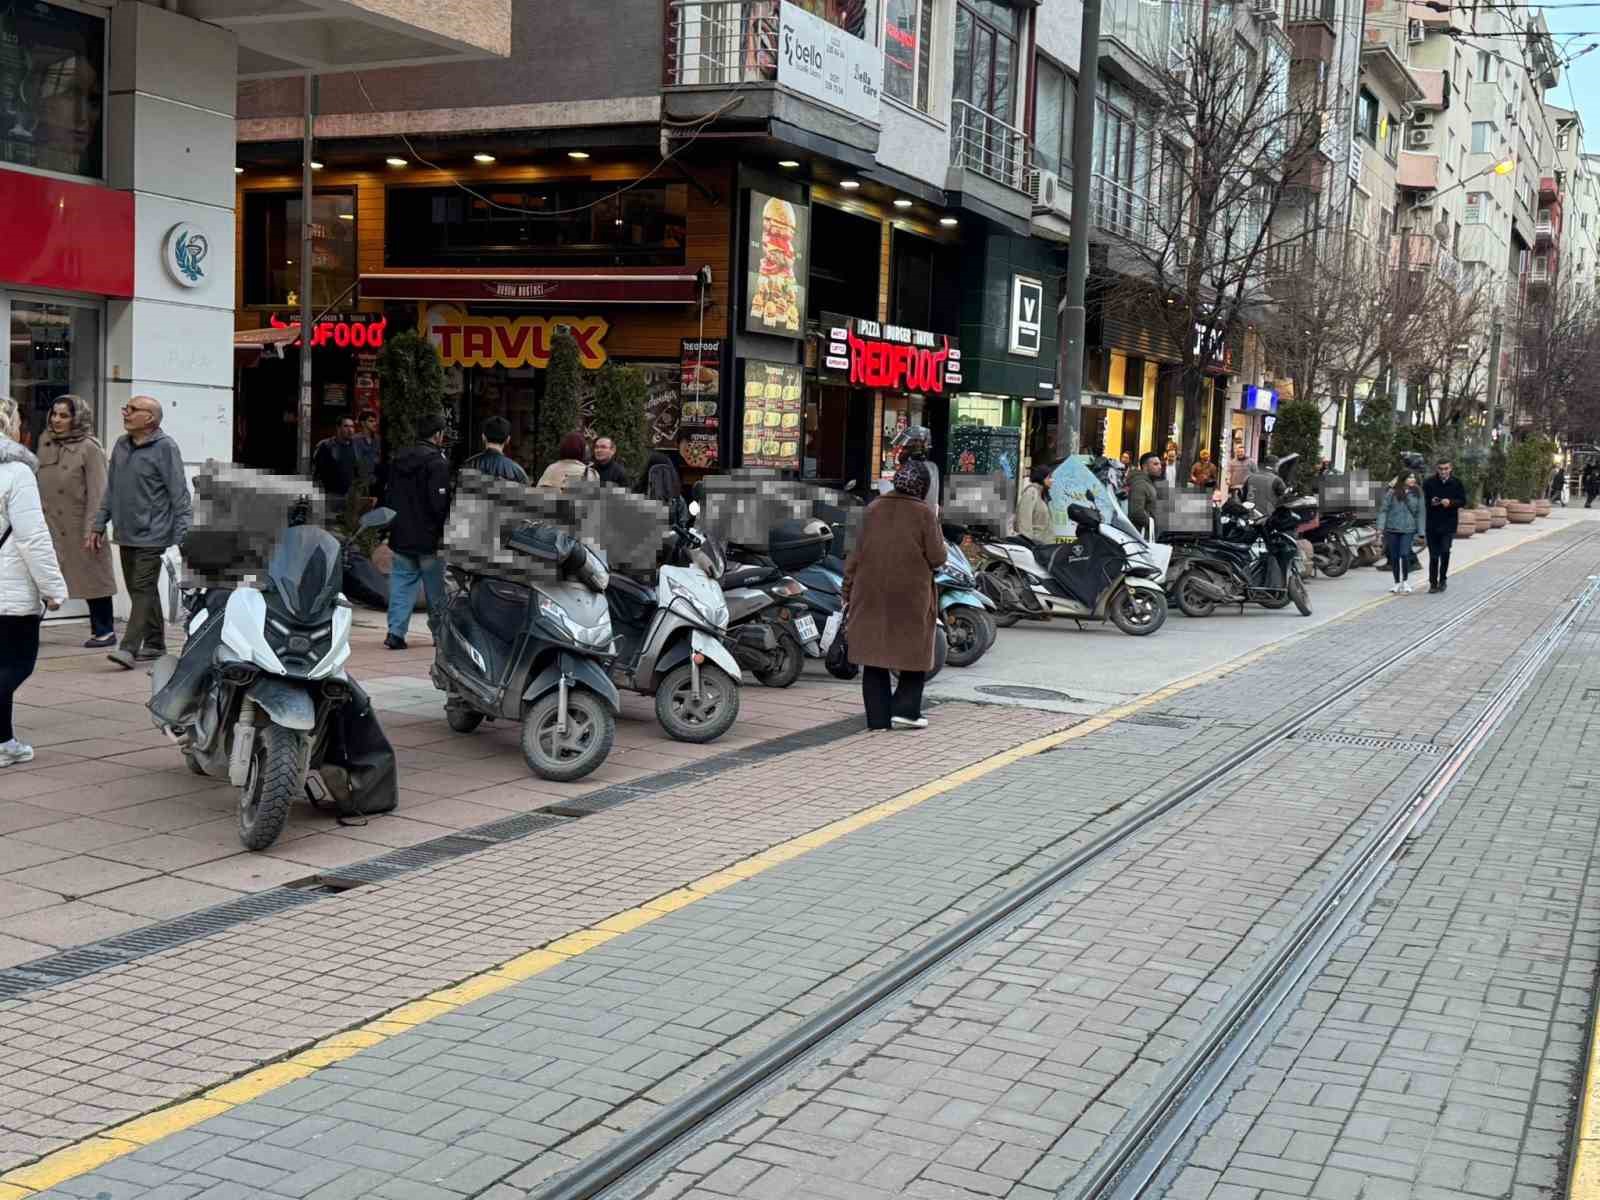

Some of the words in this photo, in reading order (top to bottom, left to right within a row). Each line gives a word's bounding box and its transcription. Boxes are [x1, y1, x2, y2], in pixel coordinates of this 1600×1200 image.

[795, 40, 822, 69] bella
[1024, 297, 1036, 322] V
[858, 319, 881, 338] PIZZA
[848, 326, 949, 393] REDFOOD
